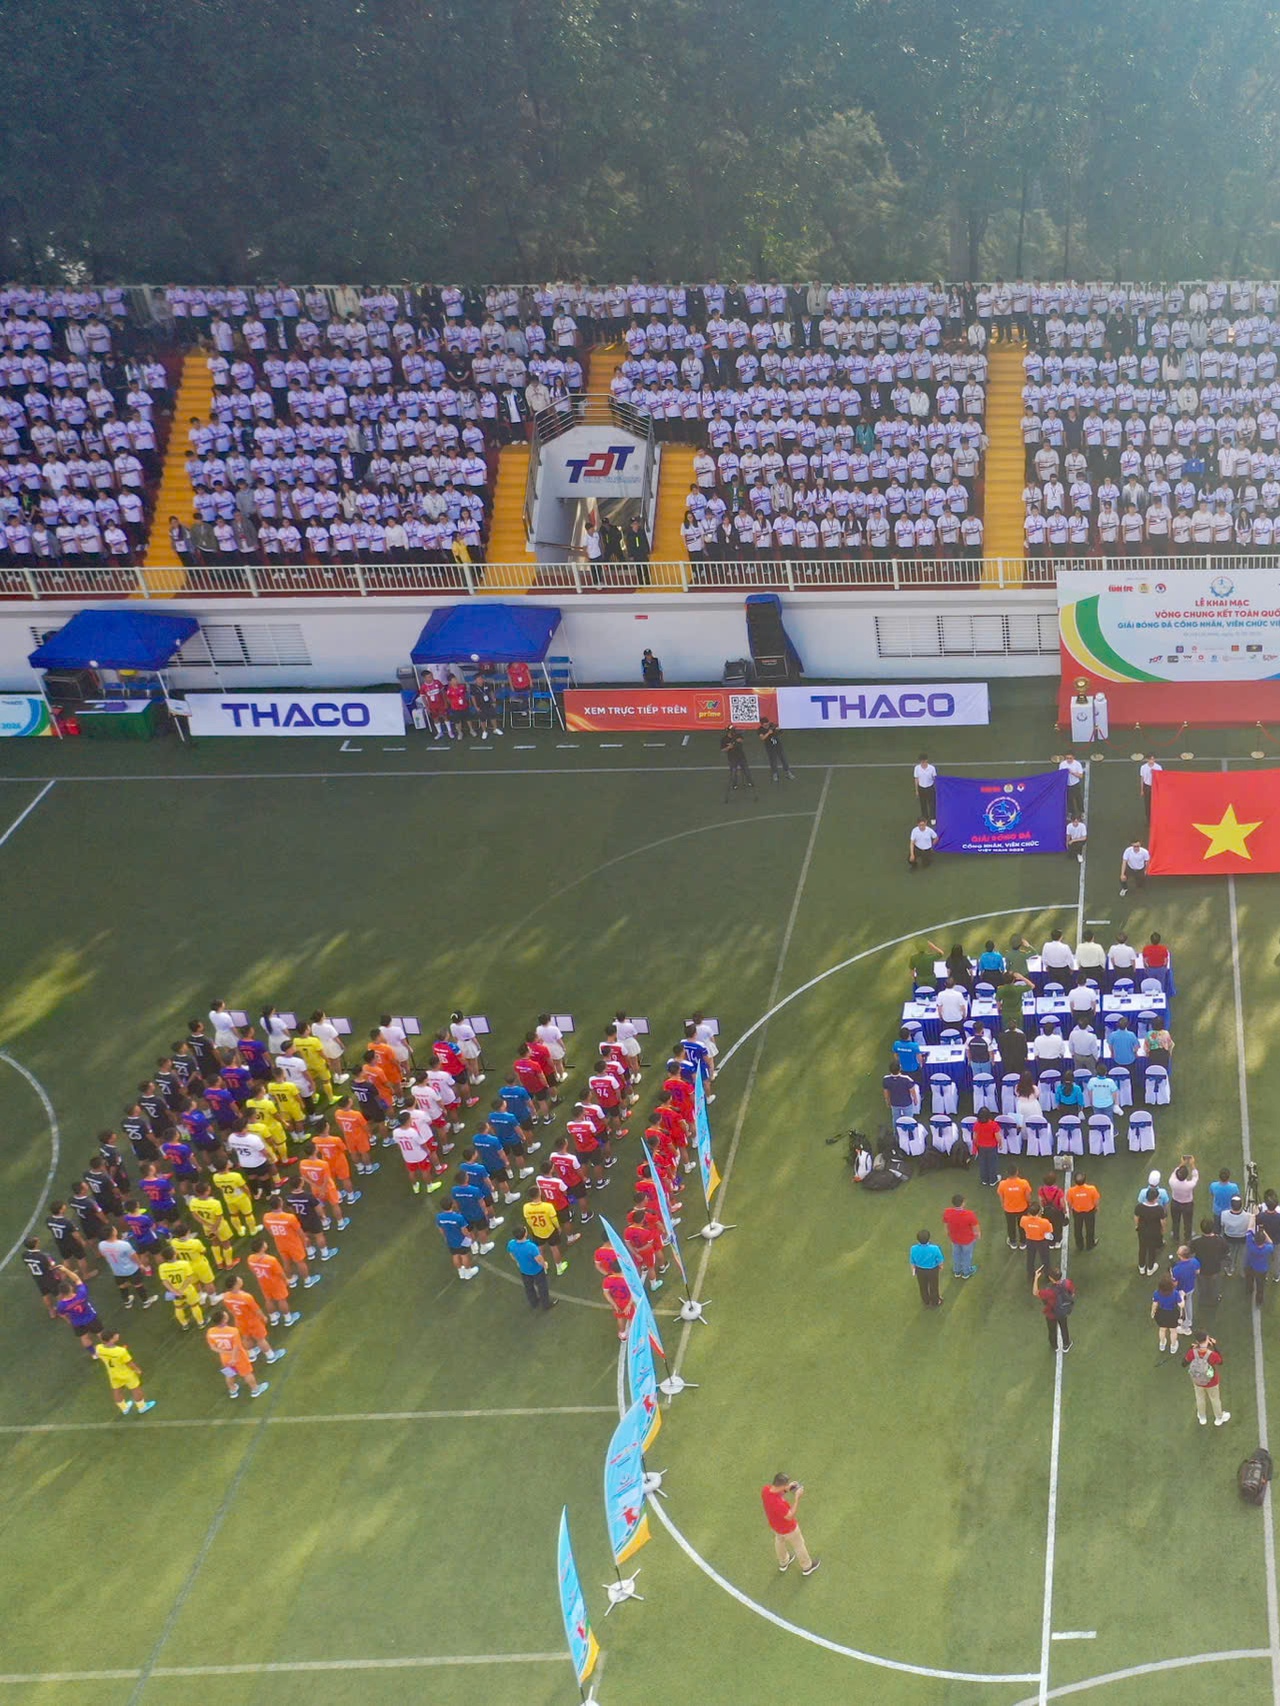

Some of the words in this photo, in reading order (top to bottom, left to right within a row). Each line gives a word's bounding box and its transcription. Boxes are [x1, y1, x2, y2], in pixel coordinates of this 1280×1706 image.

[1217, 608, 1233, 617] KẾT
[584, 706, 606, 715] XEM
[607, 706, 635, 717] TRỰC
[637, 704, 659, 715] TIẾP
[661, 704, 688, 715] TRÊN
[811, 693, 955, 720] THACO
[219, 703, 371, 727] THACO
[286, 1068, 291, 1077] 1
[596, 1089, 609, 1098] 94
[400, 1140, 414, 1151] 10
[544, 1189, 554, 1200] 13
[531, 1215, 546, 1227] 25
[270, 1225, 286, 1236] 88
[169, 1274, 182, 1284] 20
